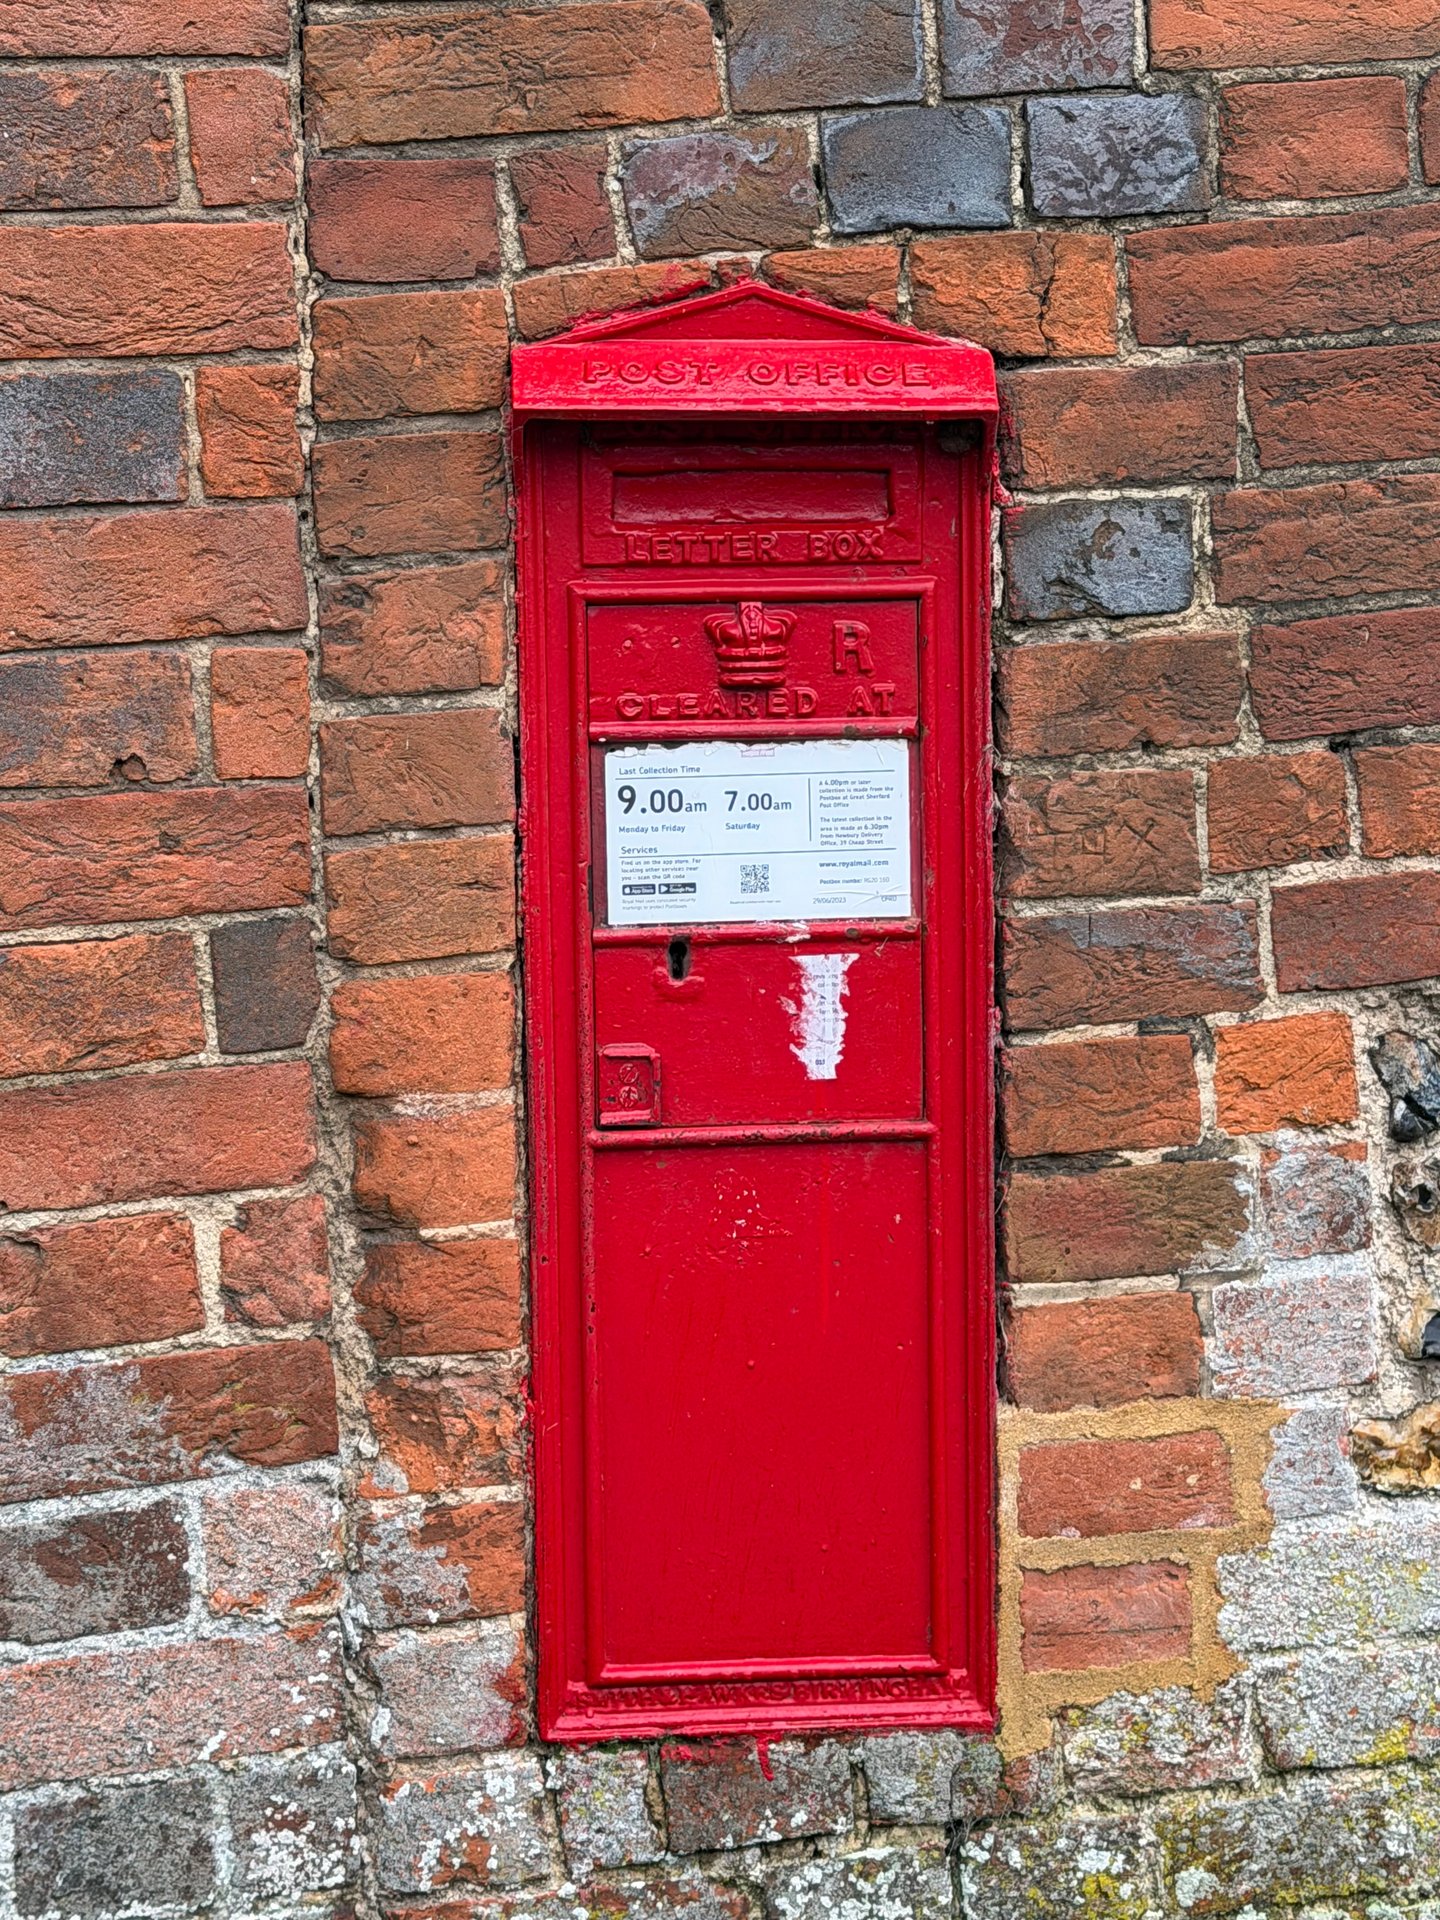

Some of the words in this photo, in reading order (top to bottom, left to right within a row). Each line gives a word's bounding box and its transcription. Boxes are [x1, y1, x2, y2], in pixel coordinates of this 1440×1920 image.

[582, 361, 718, 385] POST
[747, 363, 932, 386] OFFICE
[624, 533, 779, 563] LETTER
[807, 529, 884, 560] BOX
[832, 619, 874, 677] R
[616, 687, 819, 720] CLEARED
[848, 683, 896, 717] AT
[617, 785, 707, 814] 9.00am
[724, 791, 792, 812] 7.00am
[618, 826, 649, 834] Monday
[661, 825, 686, 833] Friday
[621, 846, 658, 855] Services
[819, 860, 889, 868] www.royalmail.com
